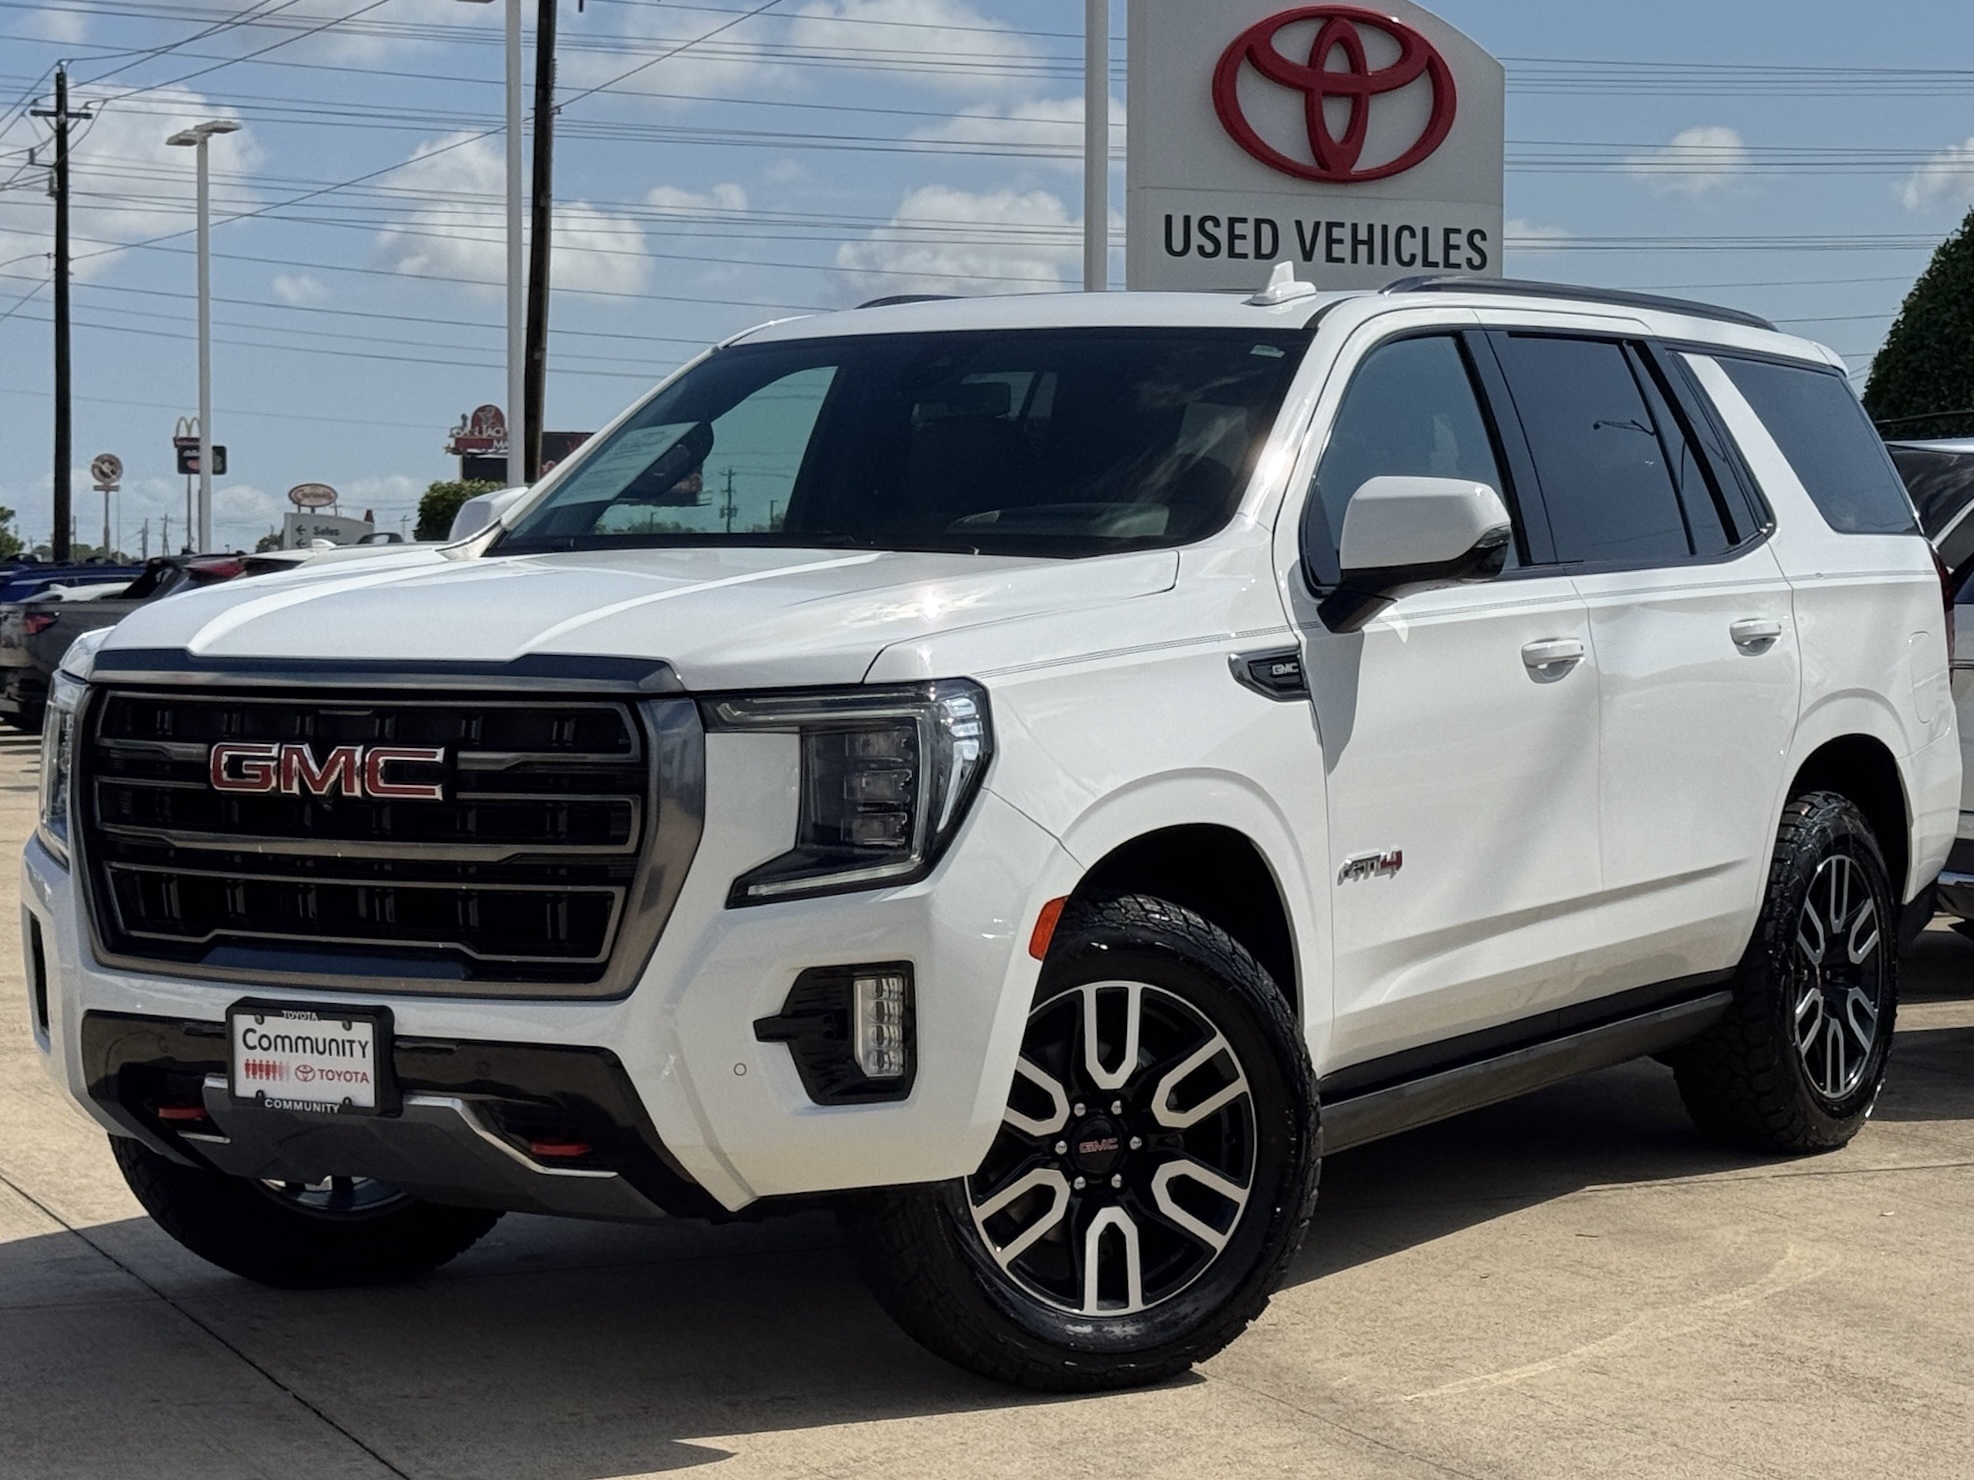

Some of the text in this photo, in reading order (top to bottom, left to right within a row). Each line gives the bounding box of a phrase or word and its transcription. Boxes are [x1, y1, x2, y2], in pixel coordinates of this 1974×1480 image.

[1164, 213, 1488, 271] USED VEHICLES
[313, 526, 340, 536] Sales
[1271, 662, 1299, 675] GMC
[210, 742, 445, 801] GMC
[282, 1010, 319, 1022] TOYOTA
[317, 1068, 370, 1084] TOYOTA
[264, 1098, 340, 1113] COMMUNITY
[1079, 1137, 1119, 1154] GMC
